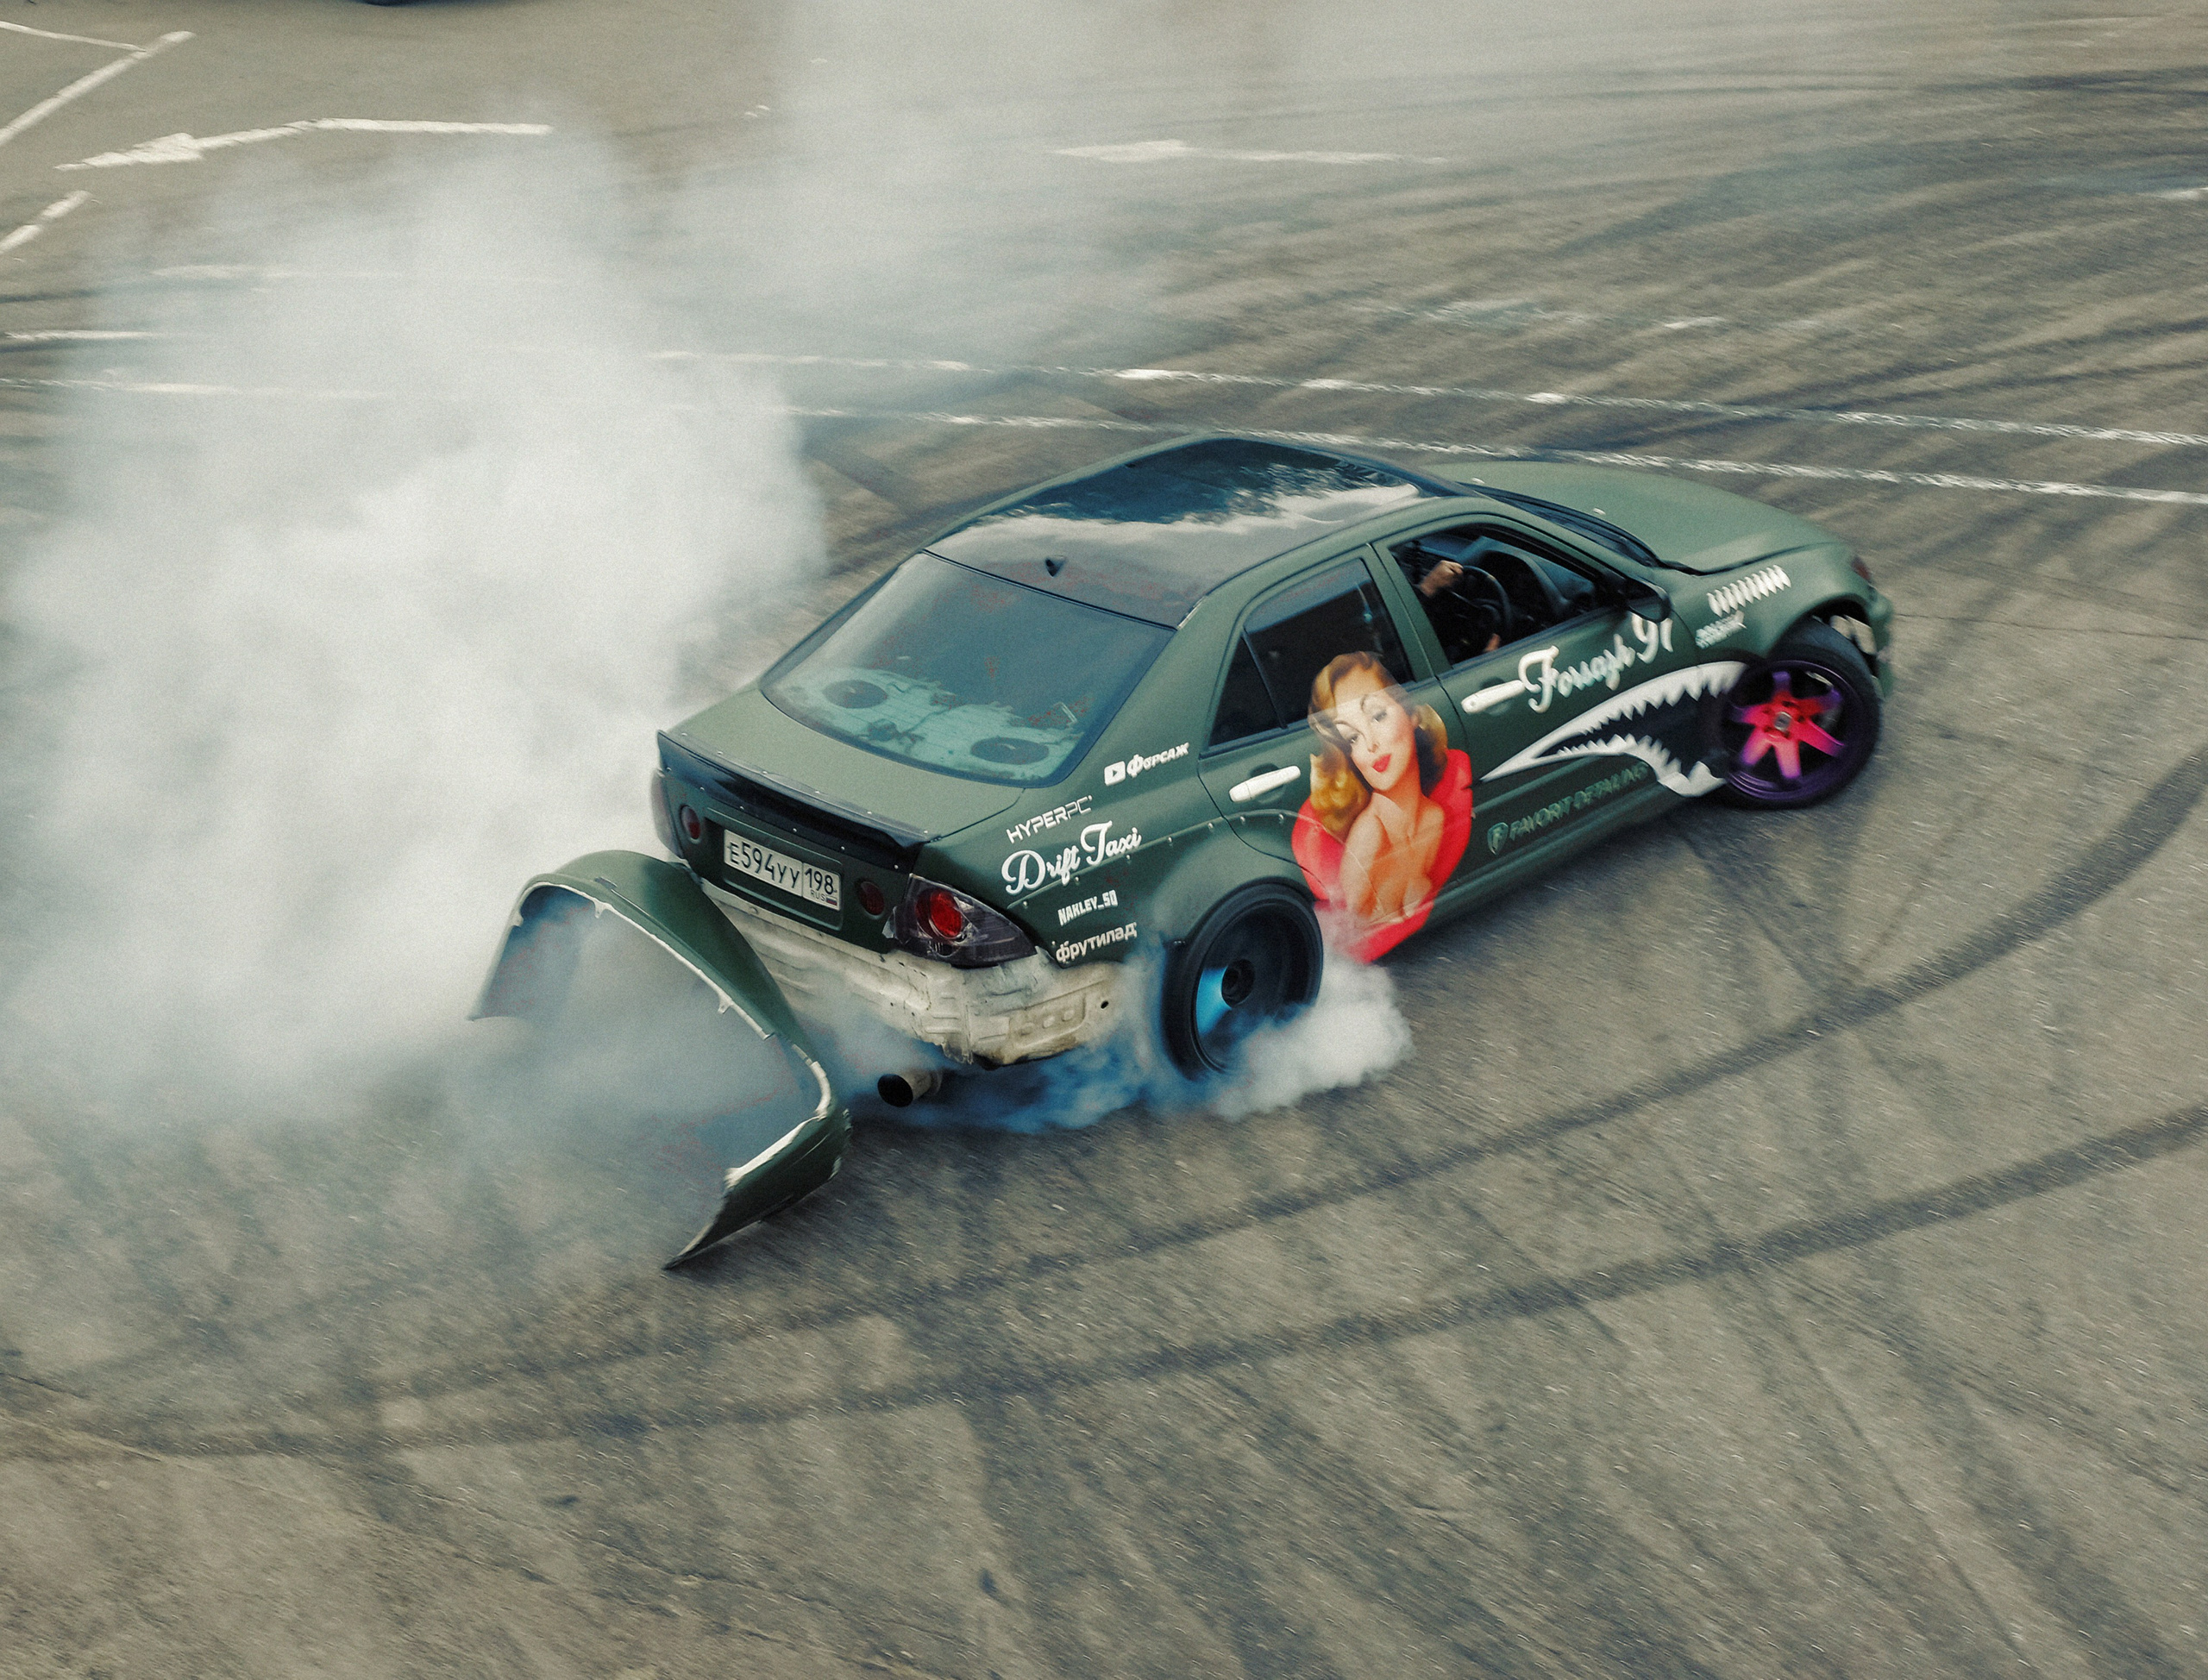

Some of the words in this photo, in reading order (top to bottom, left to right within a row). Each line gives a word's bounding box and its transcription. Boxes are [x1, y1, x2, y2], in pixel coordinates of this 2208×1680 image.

[1001, 845, 1081, 895] Drift
[1080, 820, 1142, 866] Taxi
[805, 868, 834, 895] 198
[810, 889, 825, 902] RUS
